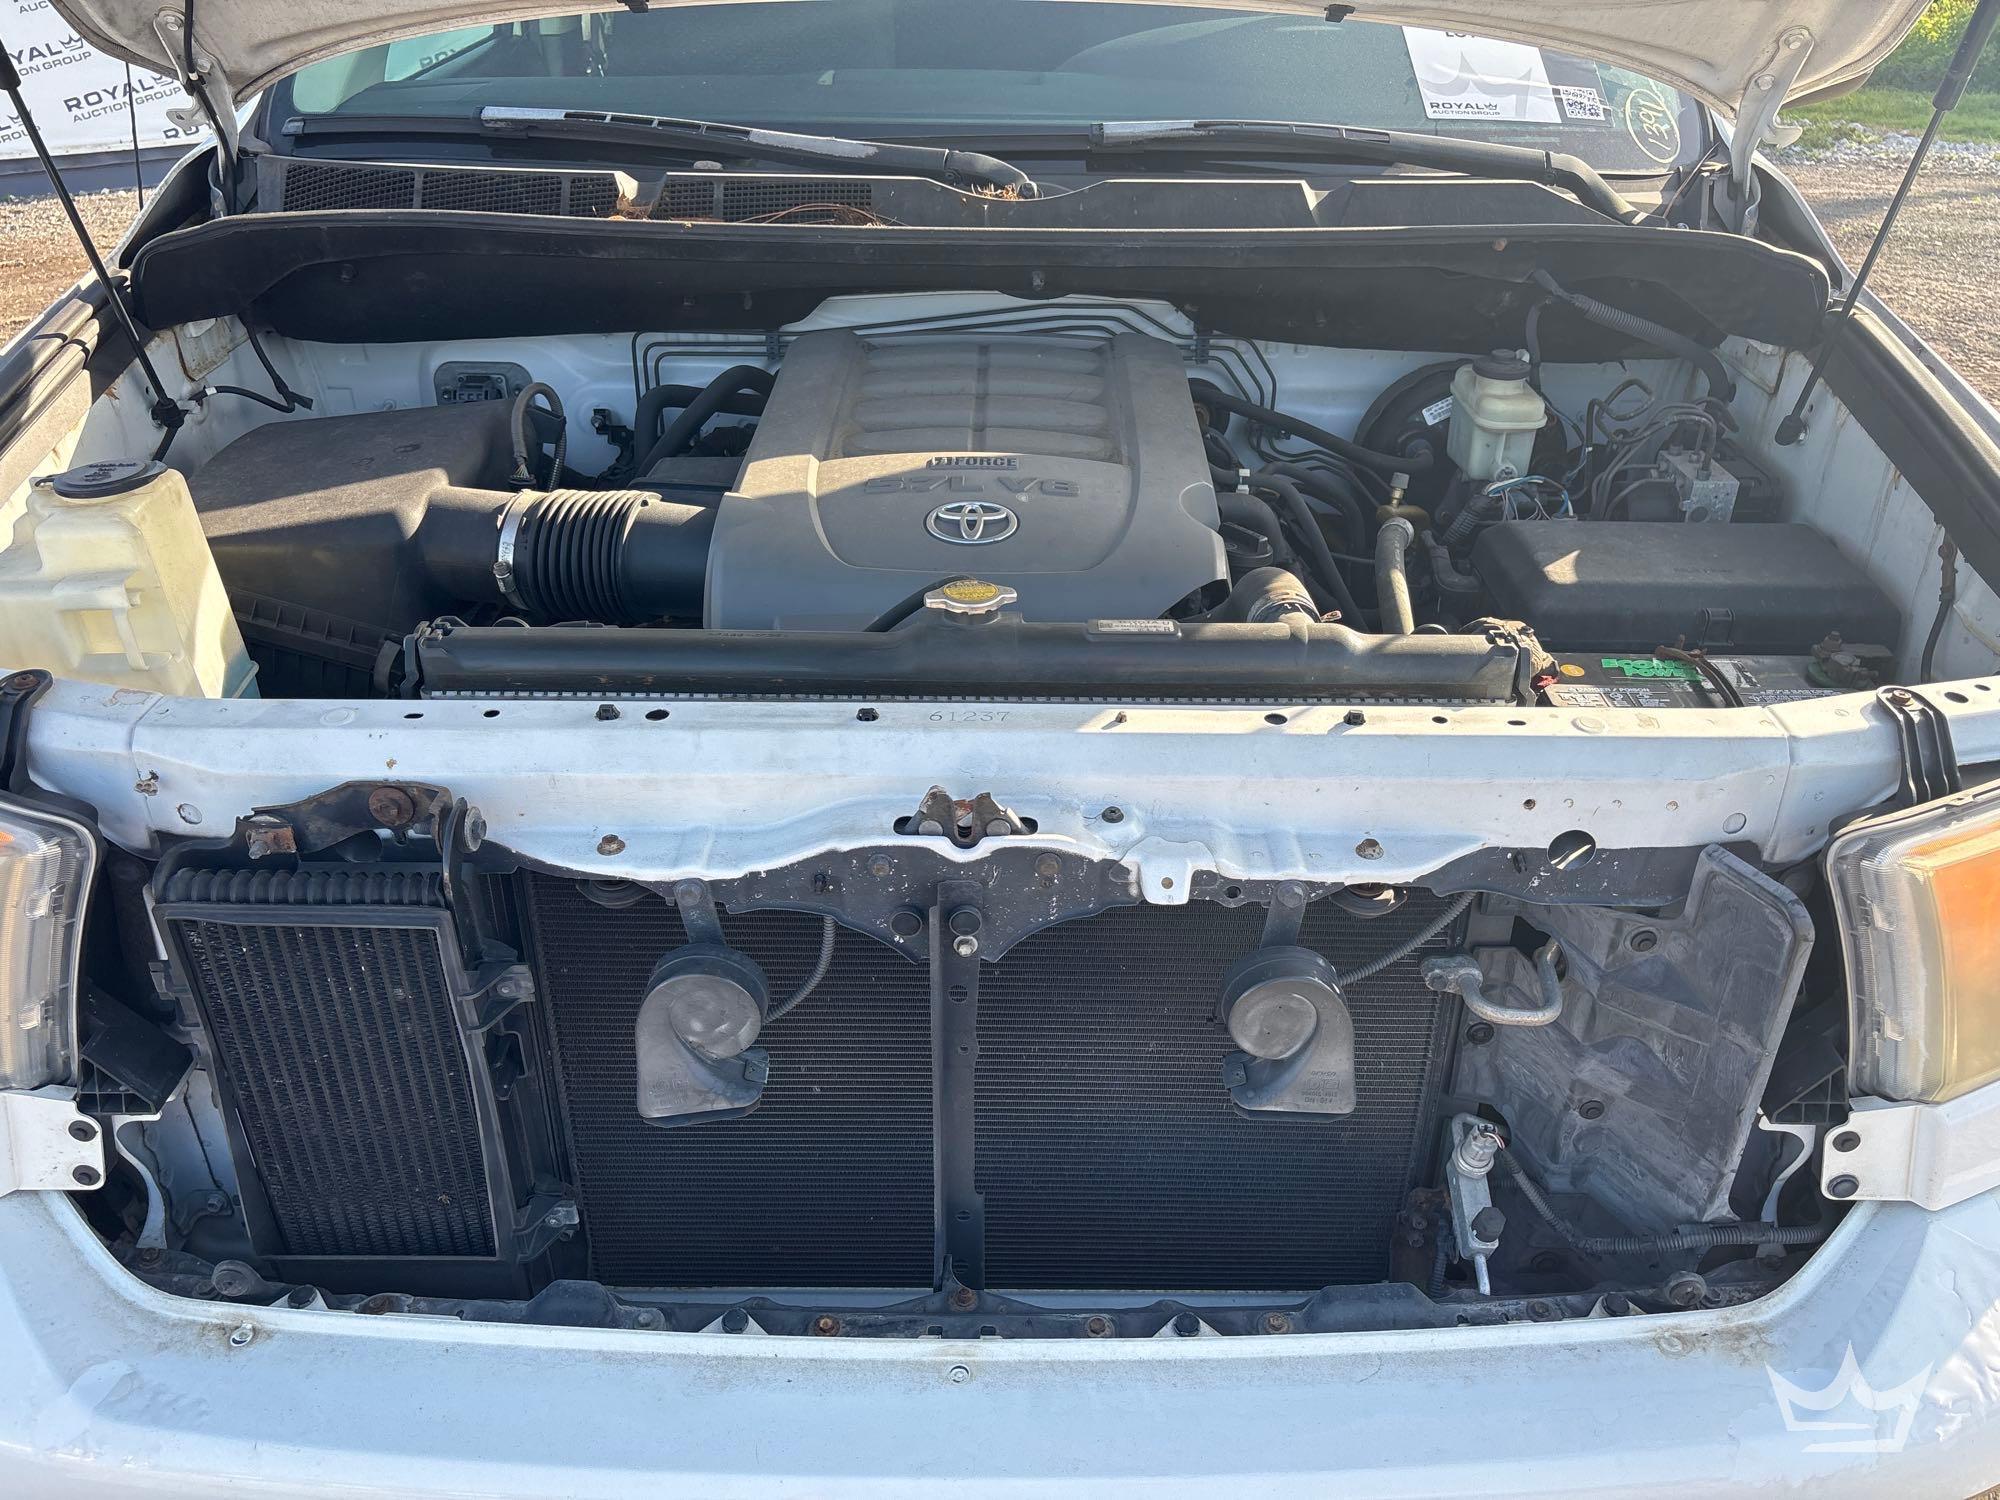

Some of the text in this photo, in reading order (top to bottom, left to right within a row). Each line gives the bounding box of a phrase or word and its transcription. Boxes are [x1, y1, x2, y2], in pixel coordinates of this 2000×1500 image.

[42, 51, 92, 70] GROUP
[63, 79, 155, 112] ROYAL
[73, 86, 182, 123] AUCTION GROUP
[1429, 102, 1485, 110] ROYAL
[929, 710, 1010, 722] 61237
